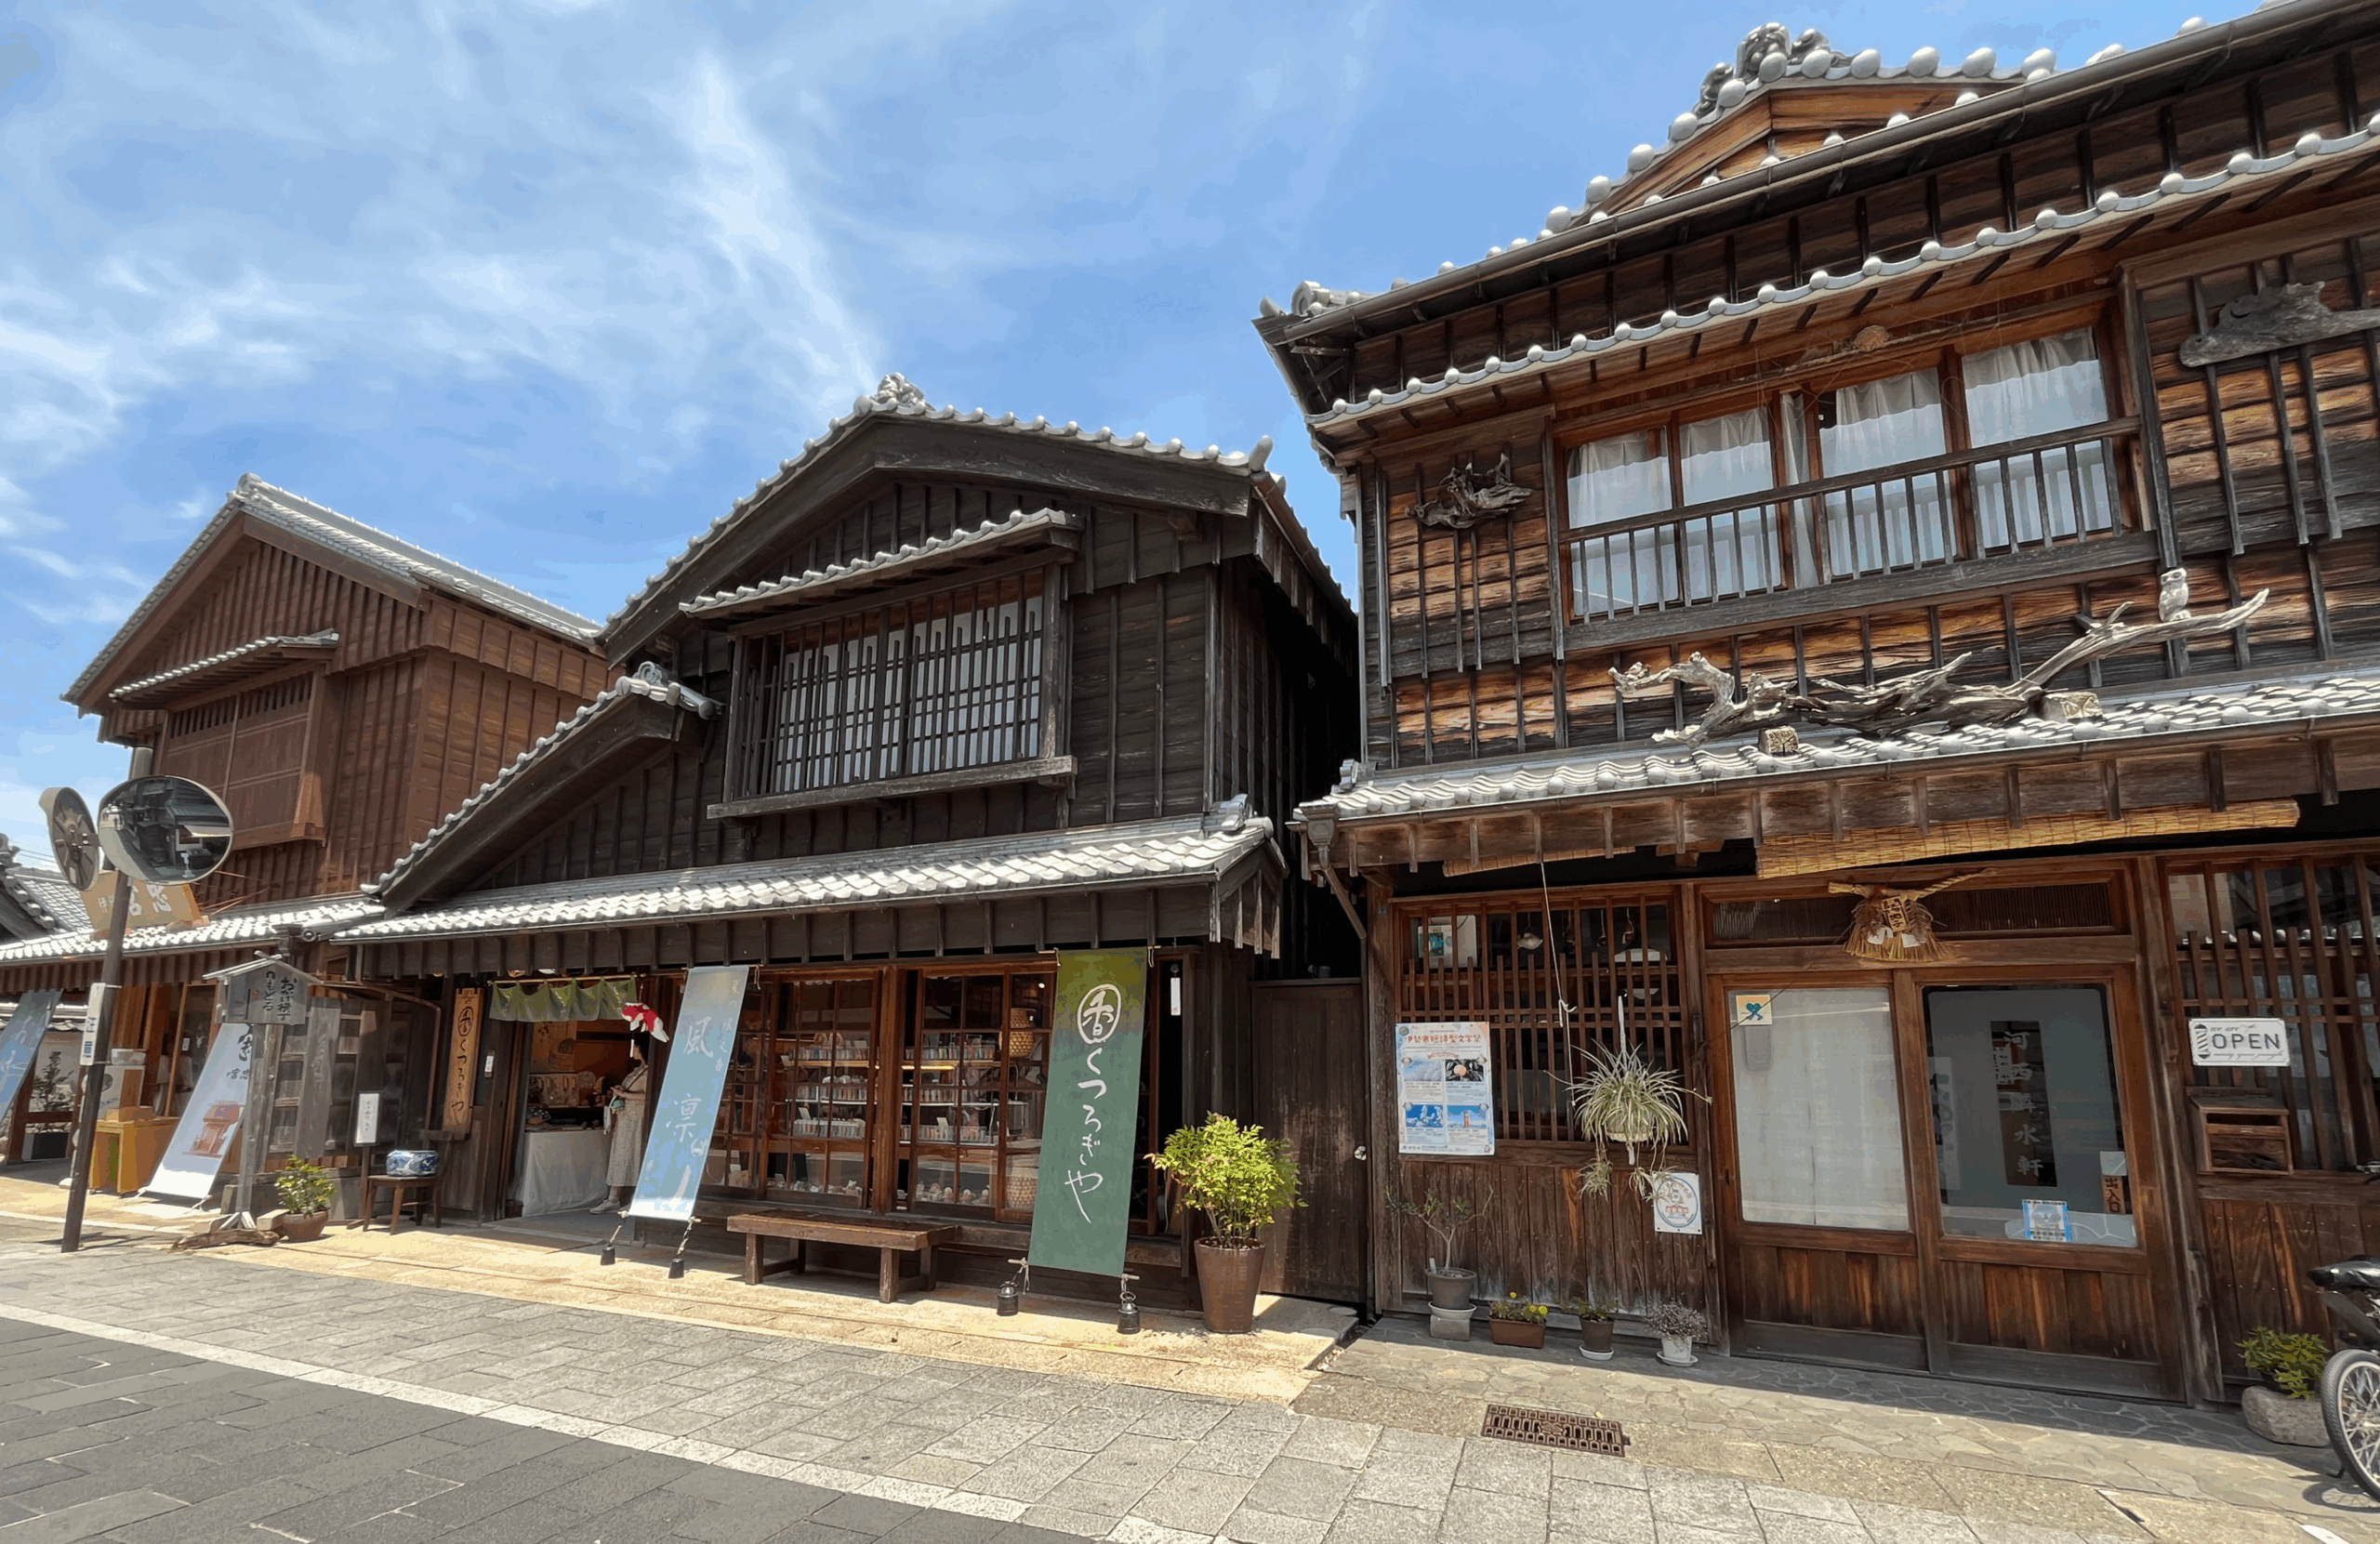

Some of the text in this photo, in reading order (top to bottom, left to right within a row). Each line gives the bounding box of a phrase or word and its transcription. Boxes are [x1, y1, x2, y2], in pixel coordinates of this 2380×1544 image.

[2212, 1033, 2281, 1049] OPEN
[2104, 1177, 2122, 1213] 出入口
